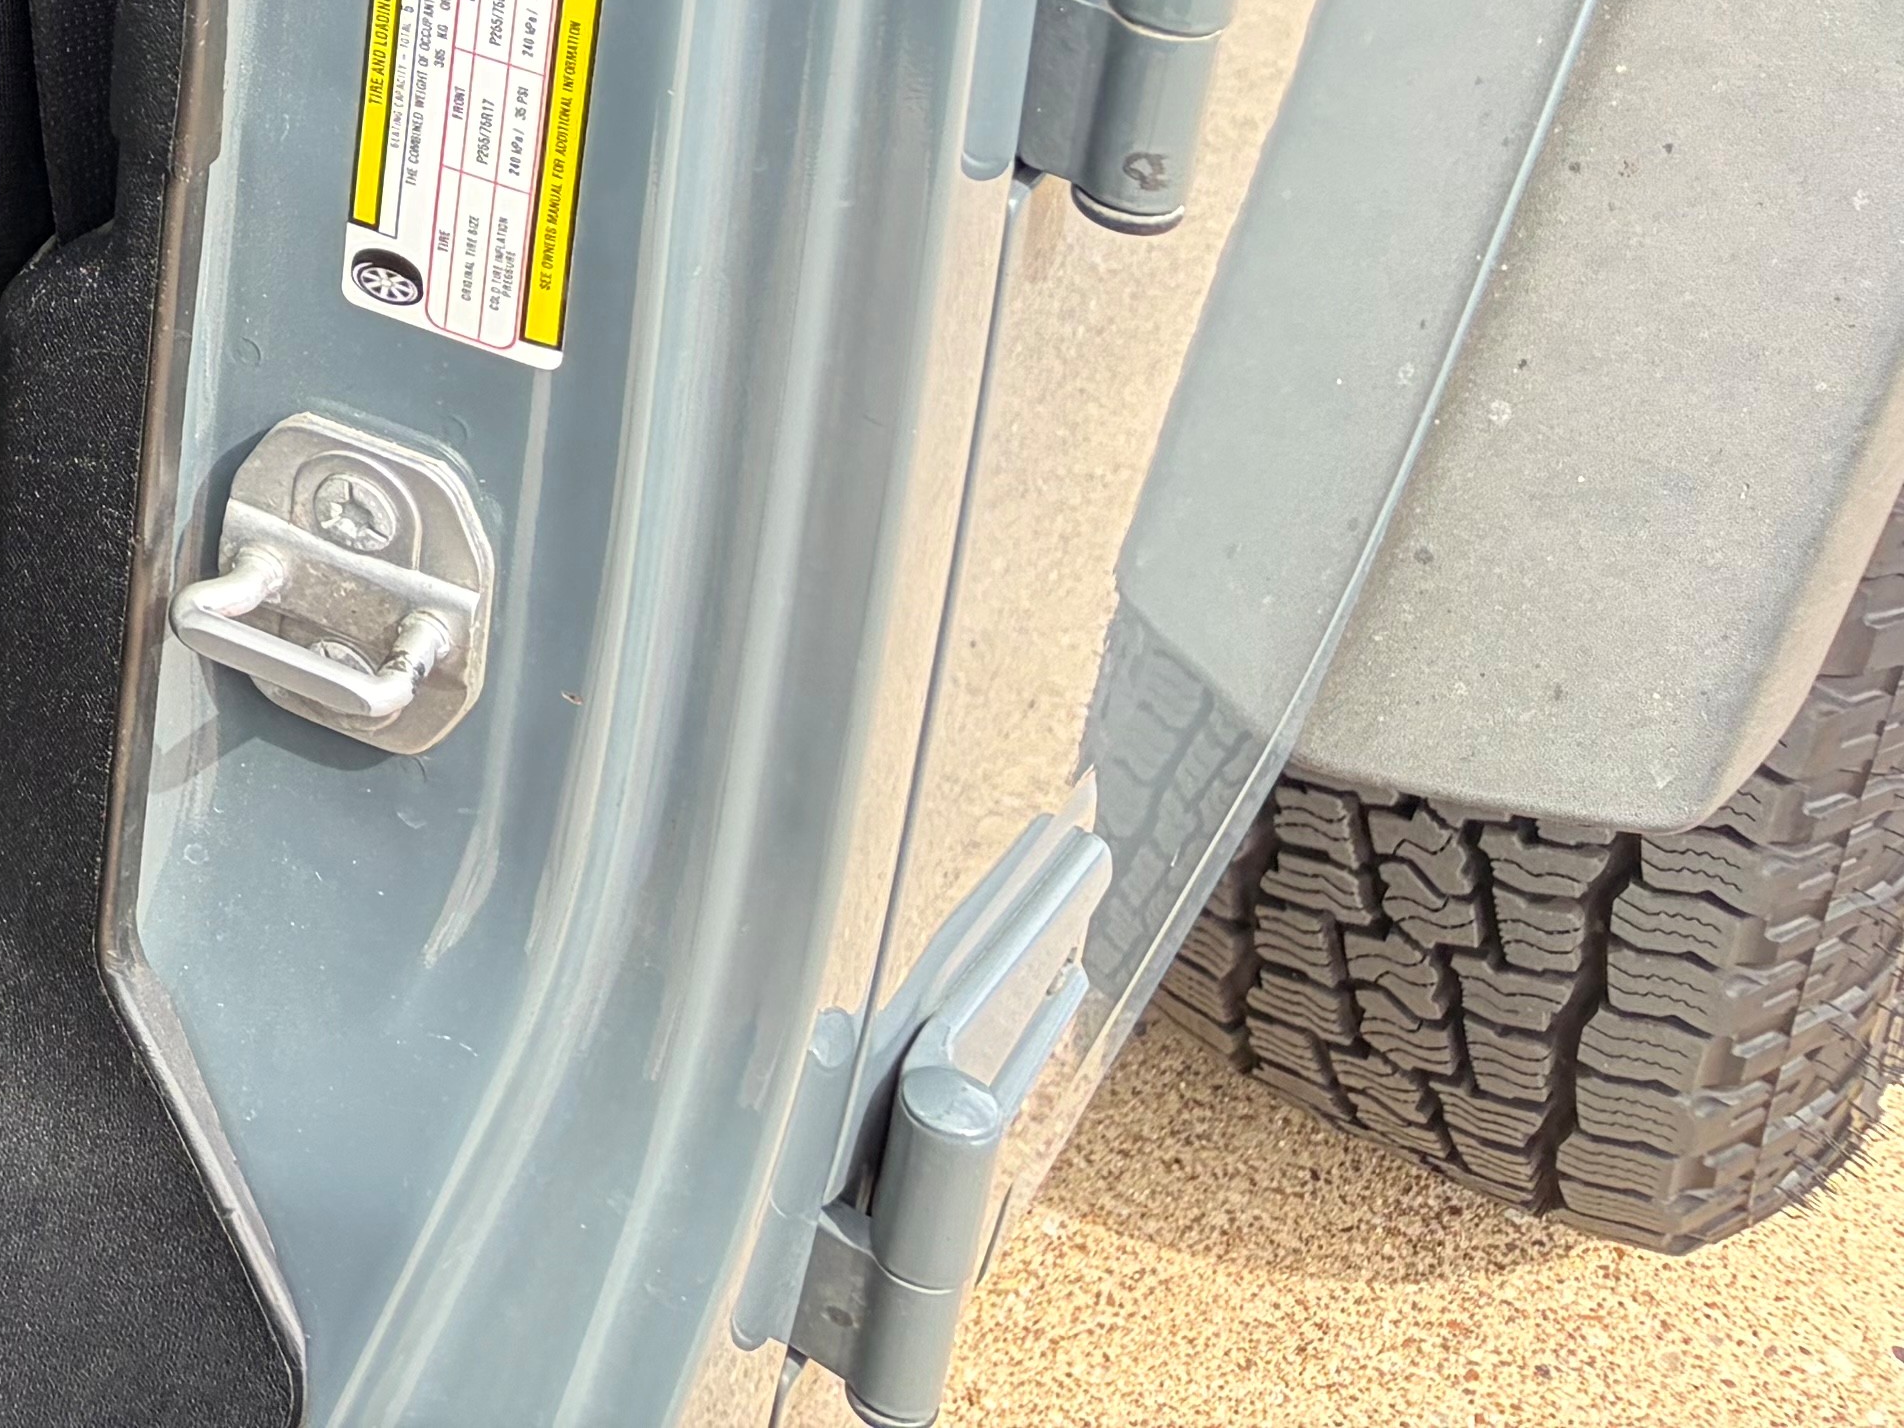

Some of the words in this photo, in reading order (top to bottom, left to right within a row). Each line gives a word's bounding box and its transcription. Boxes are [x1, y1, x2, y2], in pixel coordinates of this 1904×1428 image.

[399, 21, 411, 48] TOTAL
[521, 36, 535, 57] 240
[371, 48, 387, 76] AND
[417, 53, 429, 67] OF
[561, 19, 582, 93] INFORMATION
[368, 76, 384, 106] TIRE
[394, 63, 407, 108] CAPACITY
[413, 69, 427, 109] WEIGHT
[516, 85, 529, 104] PSI
[451, 85, 466, 120] FRONT
[514, 105, 527, 121] 35
[407, 111, 423, 165] COMBINED
[554, 94, 573, 157] ADDITIONAL
[405, 166, 417, 186] THE
[508, 155, 521, 176] 240
[551, 157, 566, 179] FOR
[546, 181, 563, 225] MANUAL
[467, 214, 479, 236] SIZE
[437, 228, 450, 253] TIRE
[465, 236, 477, 257] TIRE
[494, 215, 508, 263] INFLATION
[541, 225, 558, 270] OWNERS
[538, 271, 552, 291] SEE
